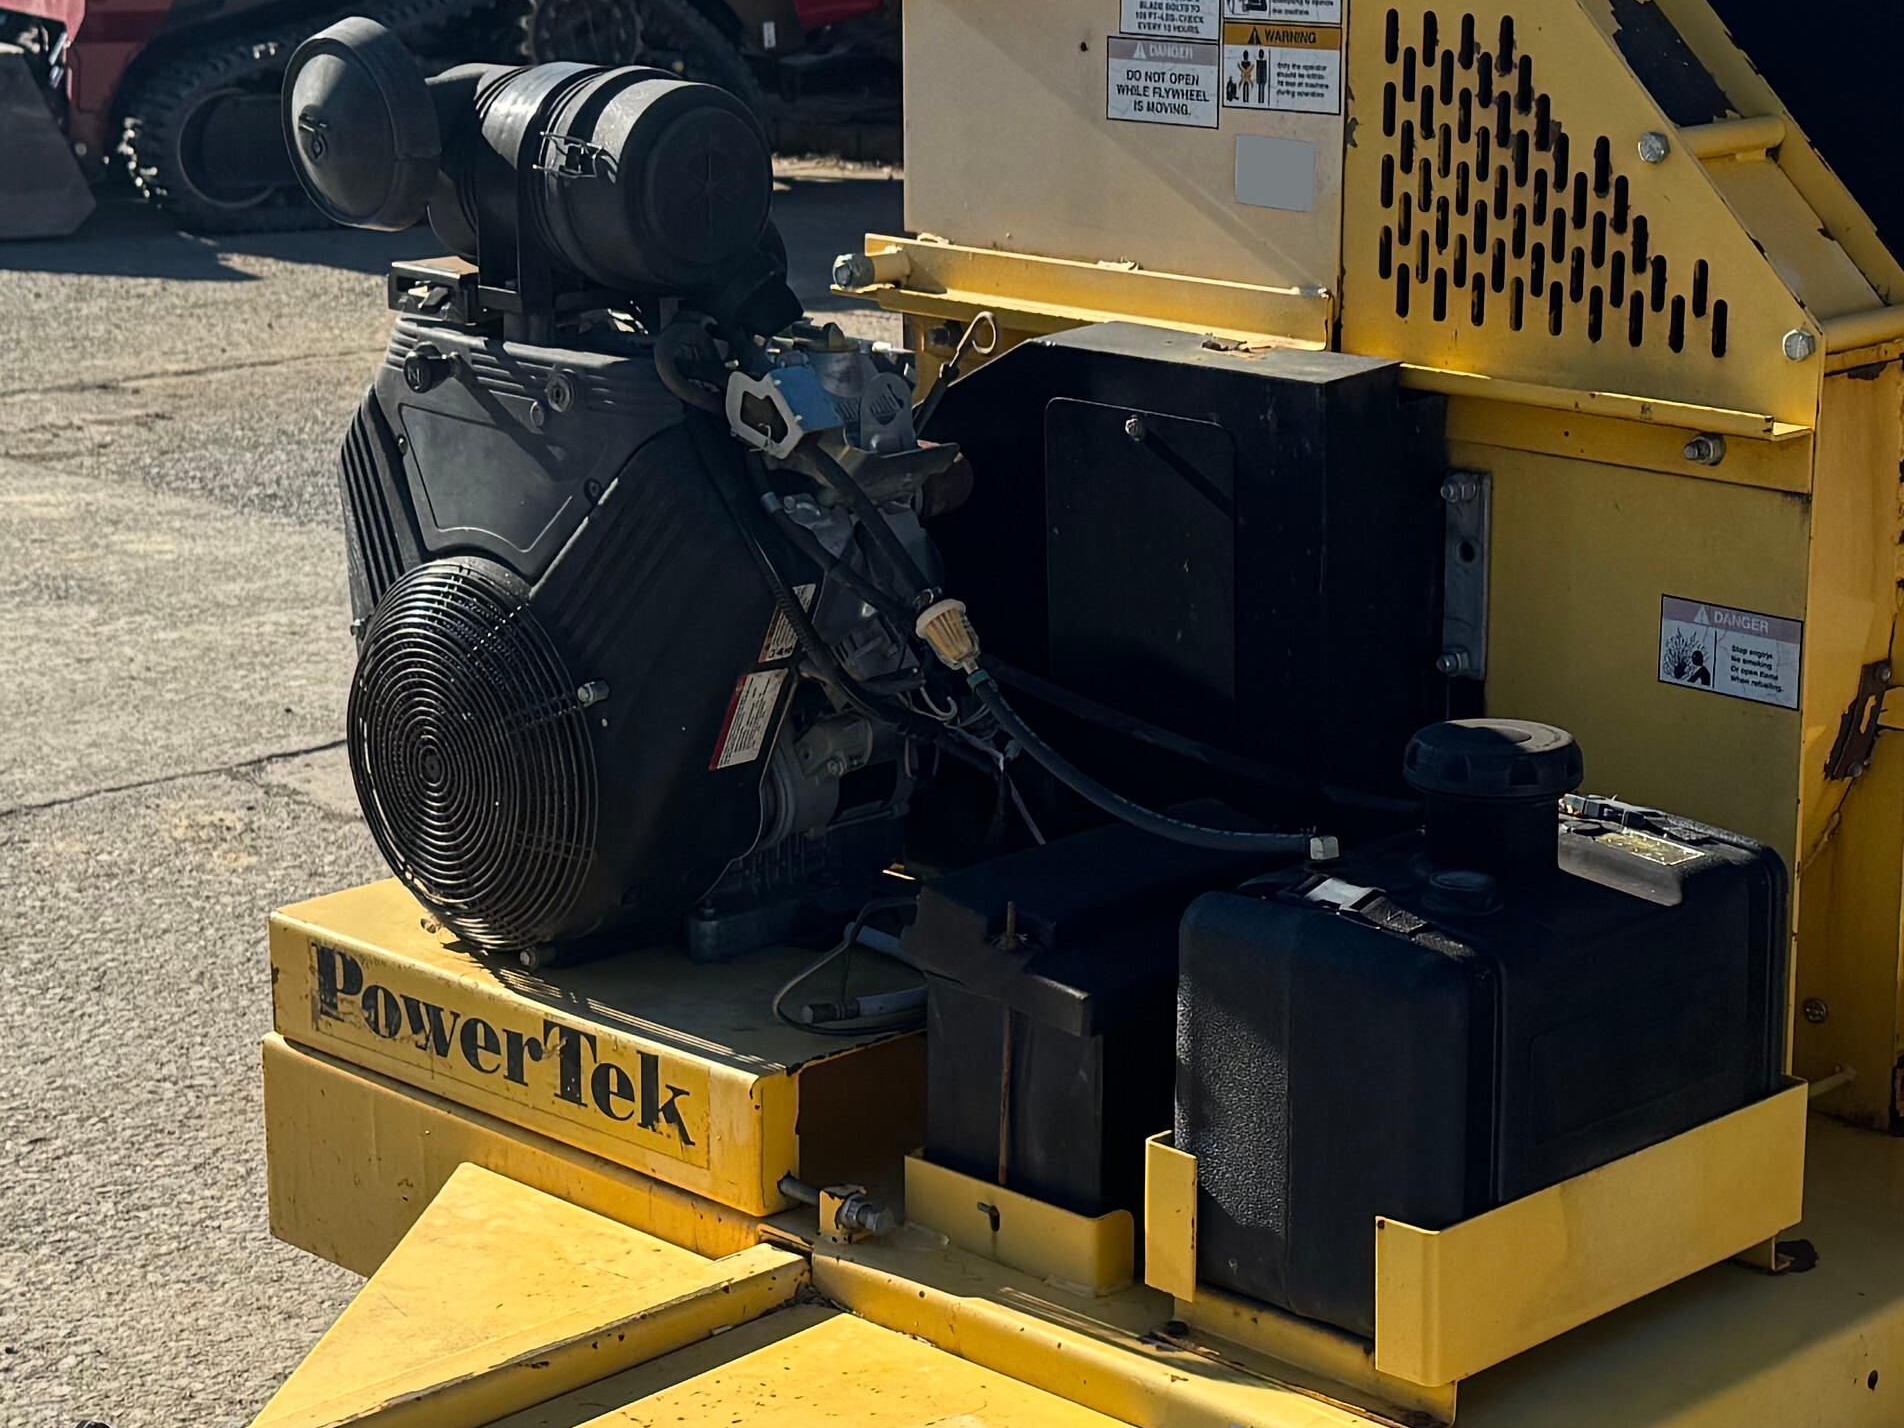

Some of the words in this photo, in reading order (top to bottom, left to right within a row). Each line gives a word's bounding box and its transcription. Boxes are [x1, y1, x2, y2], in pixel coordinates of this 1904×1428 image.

[1265, 29, 1317, 44] WARNING
[1149, 43, 1193, 60] DANGER
[1126, 69, 1142, 81] DO
[1144, 71, 1166, 83] NOT
[1169, 72, 1199, 86] OPEN
[1116, 83, 1150, 97] WHILE
[1152, 86, 1210, 102] FLYWHEEL
[1133, 99, 1144, 112] IS
[1147, 100, 1192, 116] MOVING.
[1713, 610, 1769, 635] DANGER
[1731, 644, 1748, 655] Stop
[1742, 658, 1772, 670] smoking
[310, 940, 696, 1147] PowerTek
